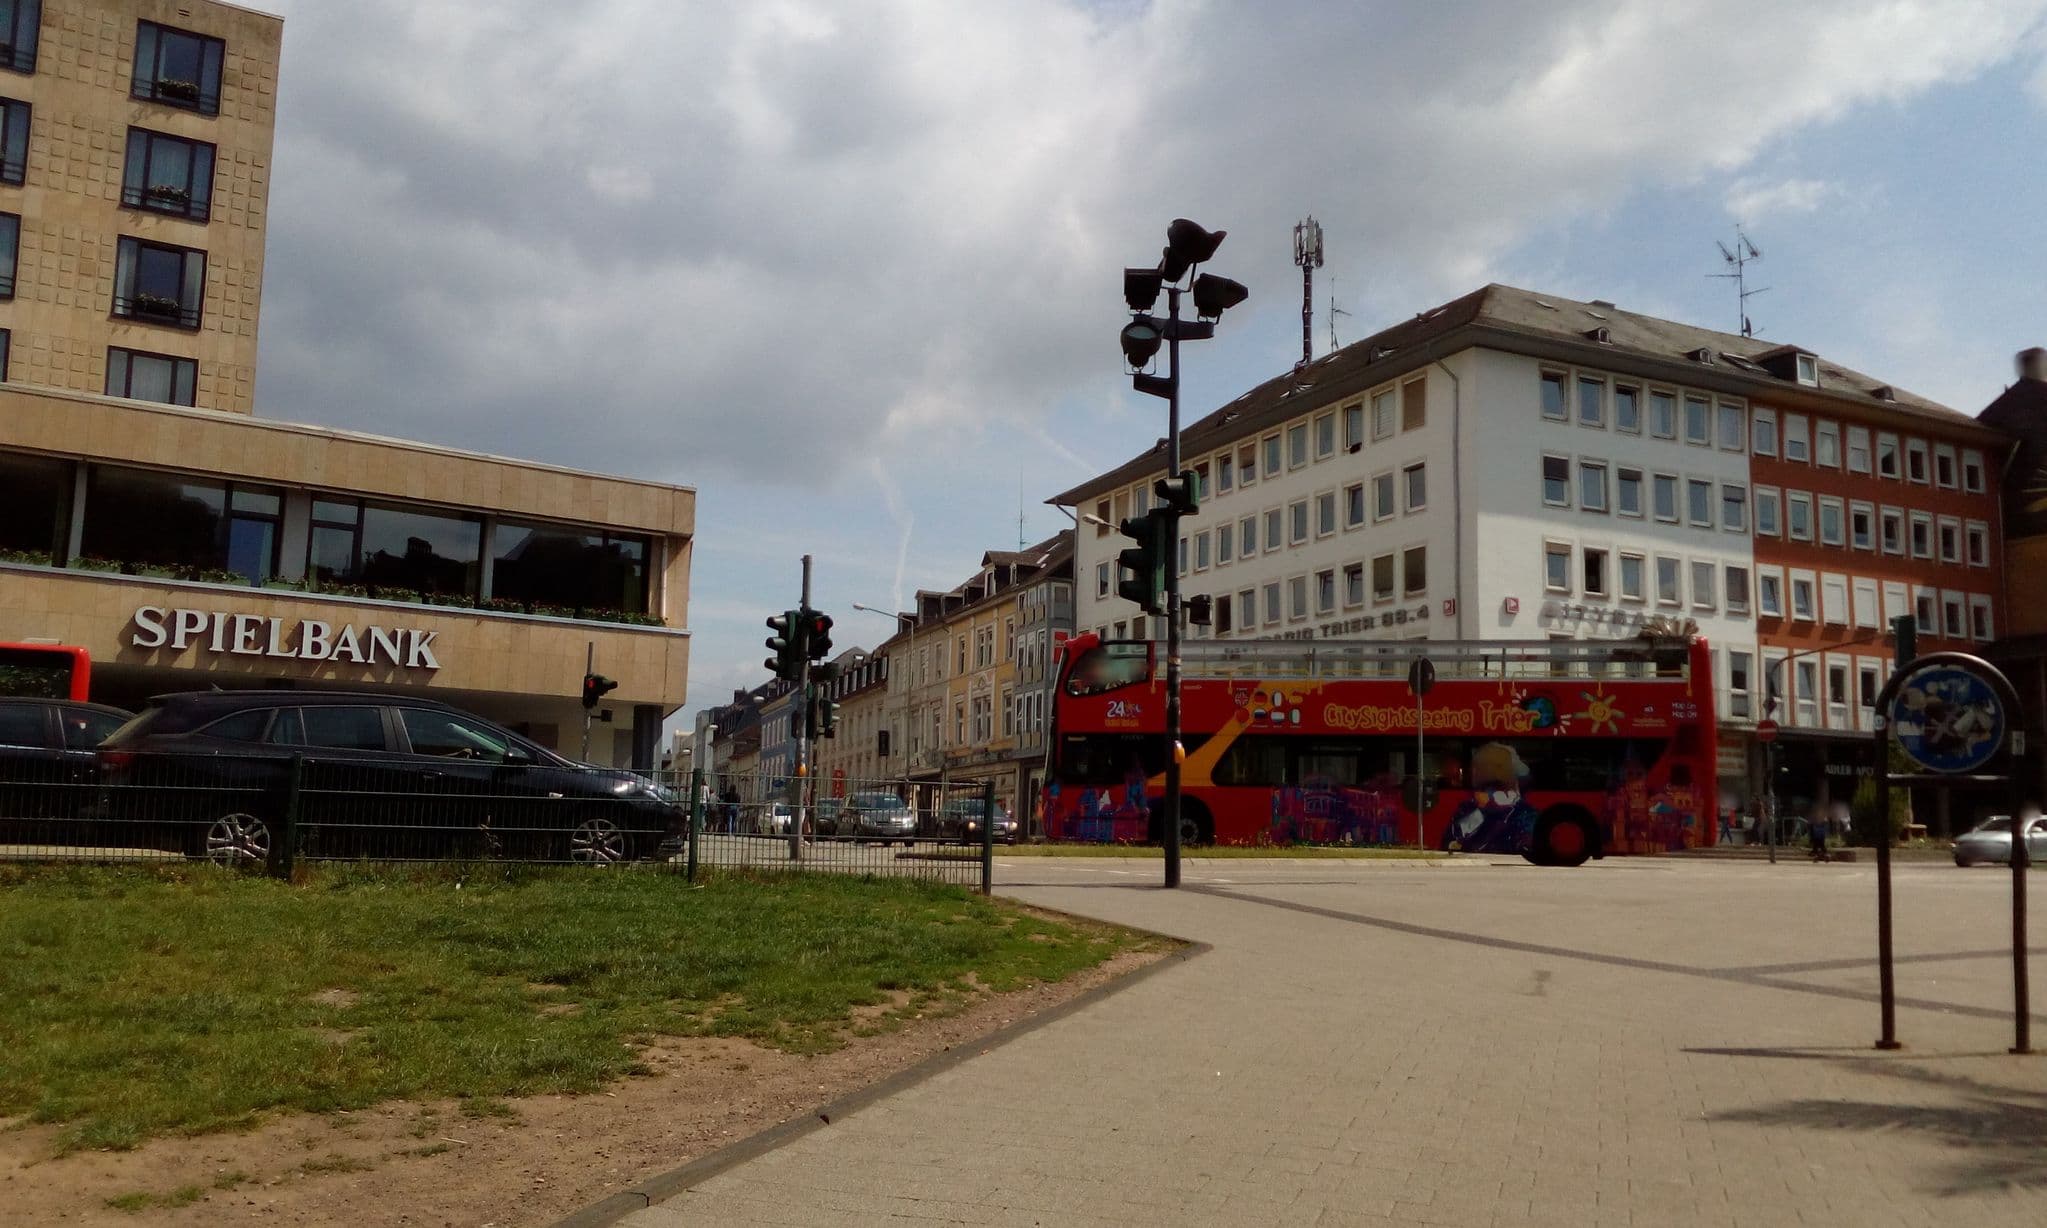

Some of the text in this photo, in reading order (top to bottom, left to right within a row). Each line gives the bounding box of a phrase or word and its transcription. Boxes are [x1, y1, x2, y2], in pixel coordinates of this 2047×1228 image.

[133, 605, 441, 669] SPIELBANK
[1320, 615, 1374, 638] TRIER
[1323, 700, 1541, 732] CitySightseeing Trier
